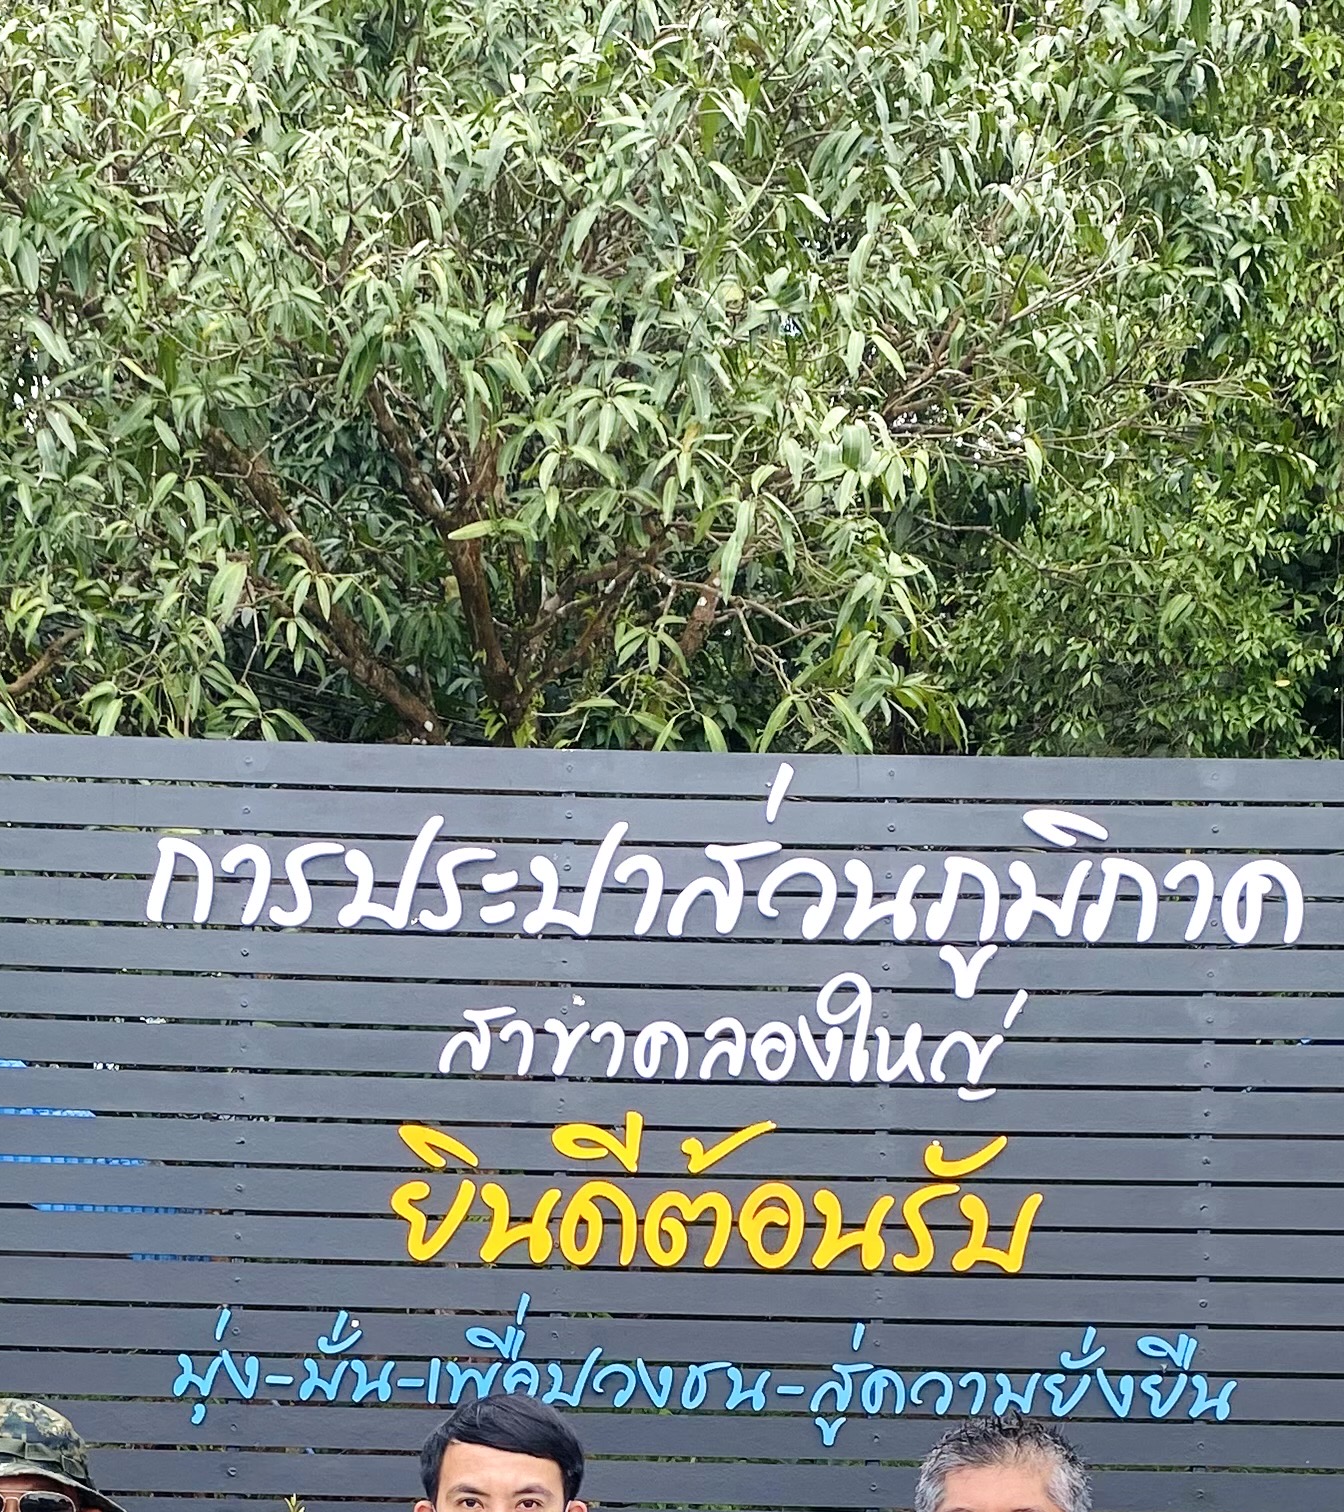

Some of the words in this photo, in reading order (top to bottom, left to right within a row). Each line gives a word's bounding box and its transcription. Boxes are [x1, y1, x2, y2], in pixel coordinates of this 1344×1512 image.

[146, 762, 1304, 999] การประปาส่วนภูมิภาค
[438, 972, 1030, 1101] สาขาคลองใหญ่
[390, 1111, 1044, 1274] ยินดีต้อนรับ
